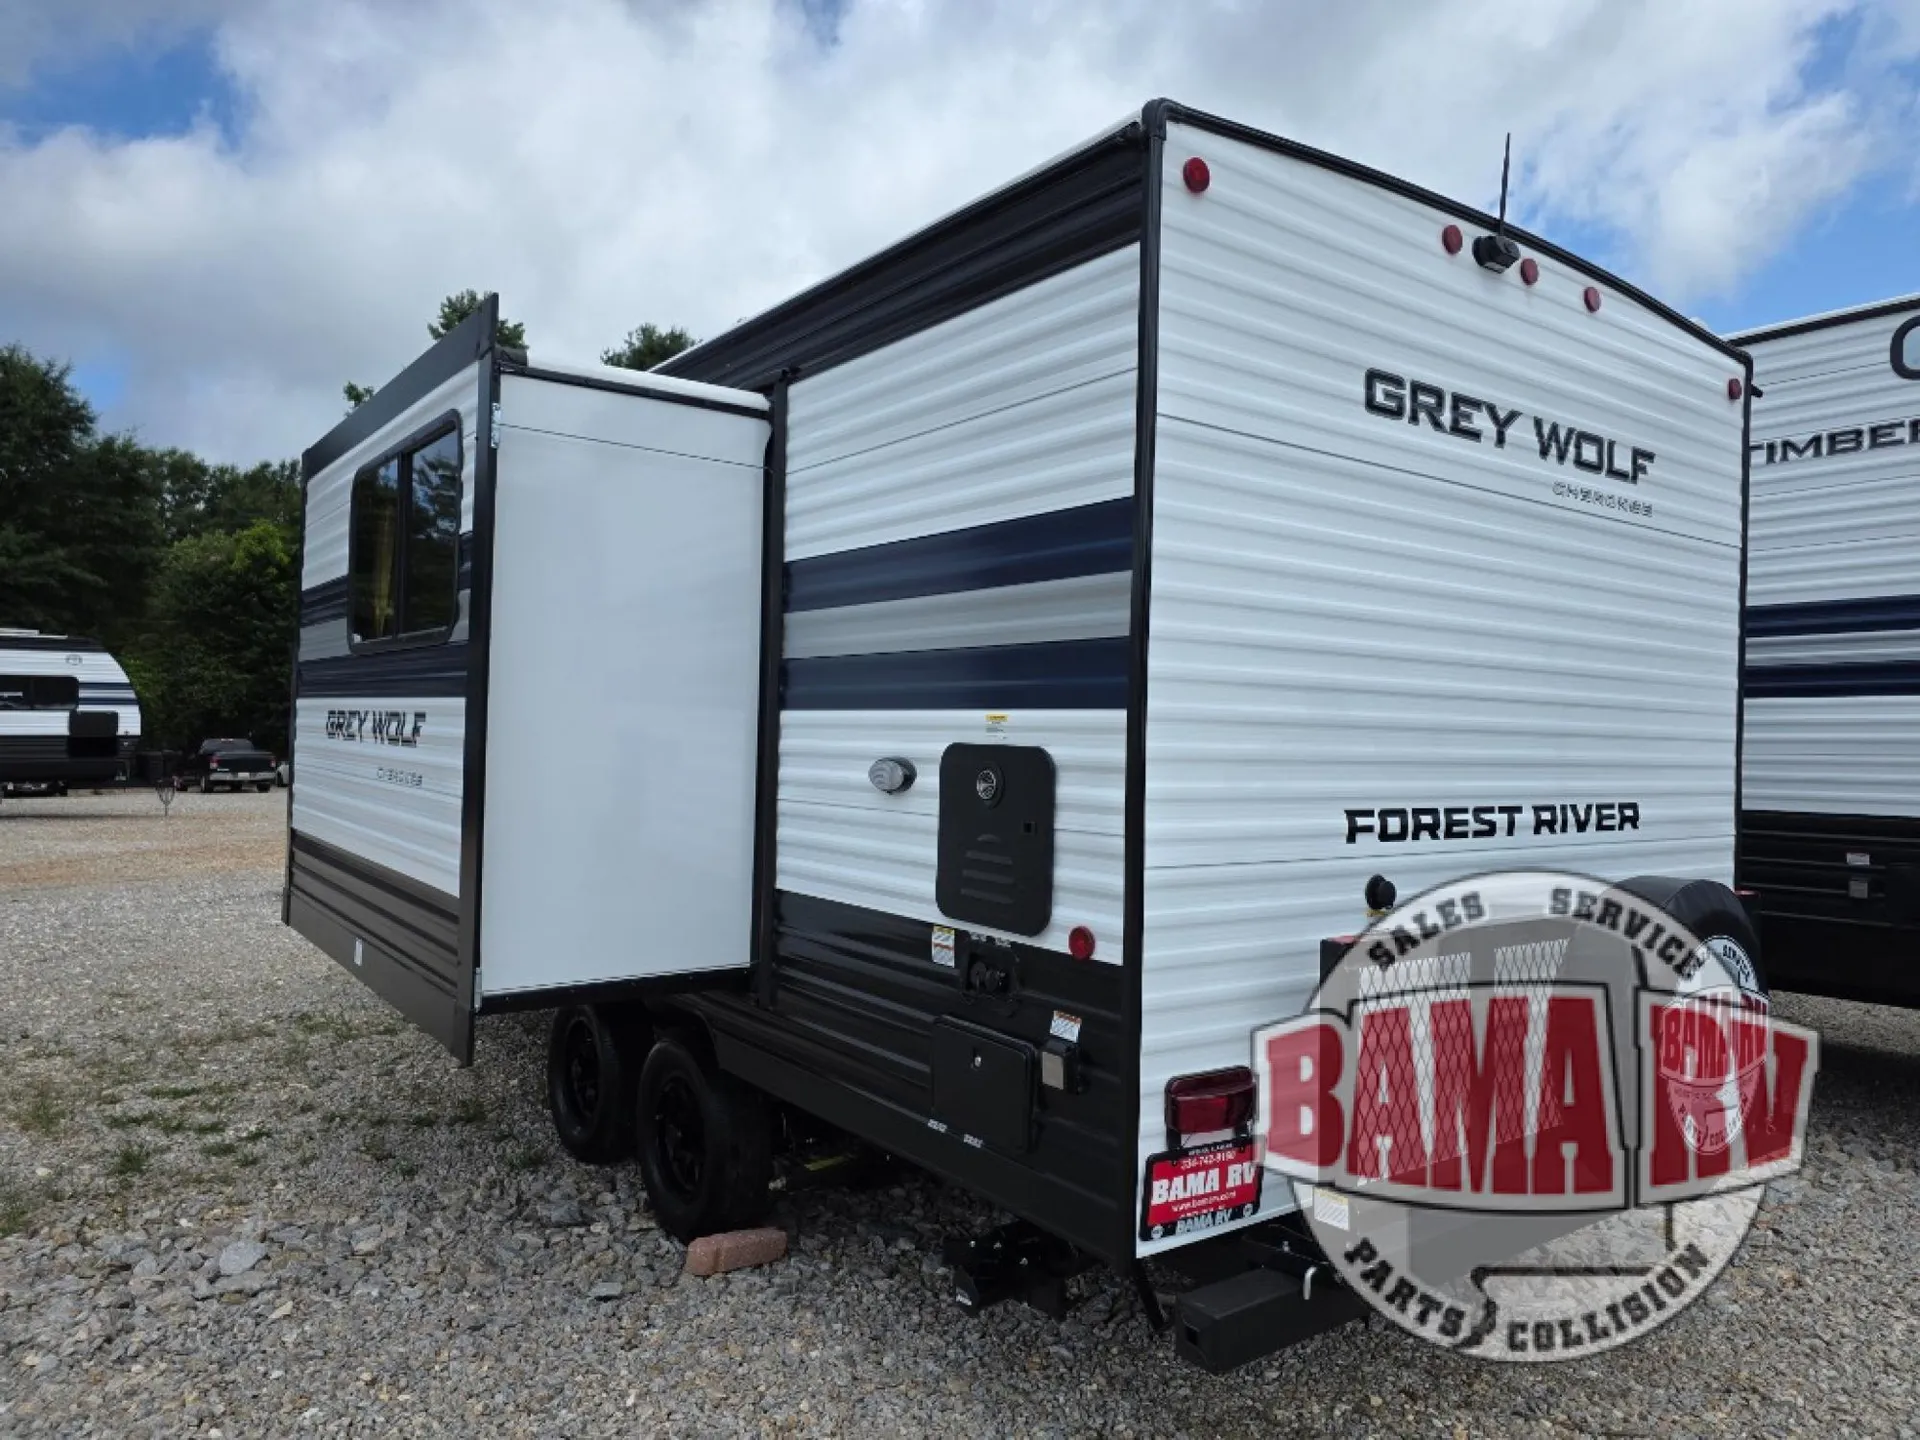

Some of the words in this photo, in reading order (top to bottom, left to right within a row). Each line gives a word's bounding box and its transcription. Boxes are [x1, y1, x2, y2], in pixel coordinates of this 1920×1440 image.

[1365, 367, 1523, 449] GREY
[1533, 415, 1656, 484] WOLF
[1750, 418, 1920, 464] IMBE
[1552, 481, 1653, 518] CHEROKEE
[326, 709, 369, 743] GREY
[371, 710, 426, 748] WOLF
[1344, 805, 1523, 844] FOREST
[1532, 802, 1640, 835] RIVER
[1151, 1168, 1219, 1205] BAMA
[1226, 1161, 1256, 1189] RV
